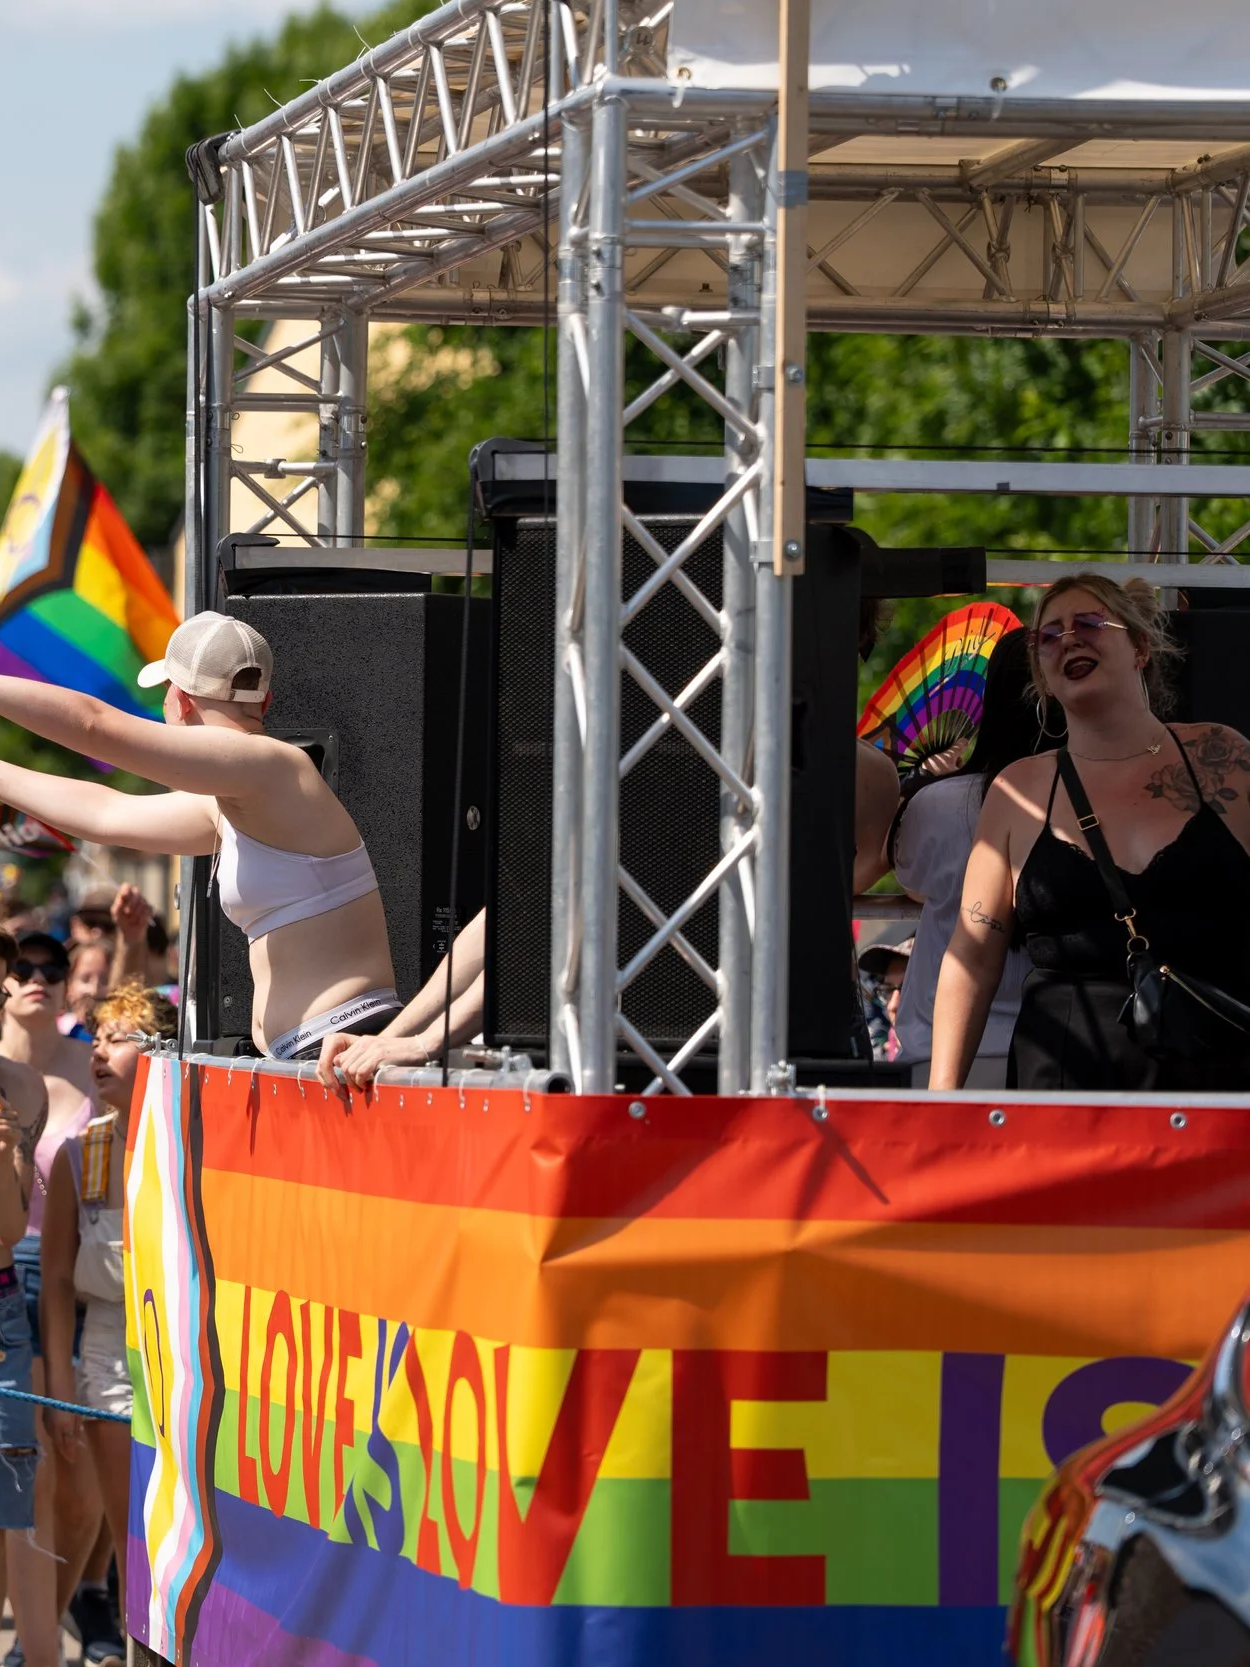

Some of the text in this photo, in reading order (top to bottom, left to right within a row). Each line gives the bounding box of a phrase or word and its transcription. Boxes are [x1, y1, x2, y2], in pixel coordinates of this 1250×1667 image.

[330, 999, 382, 1026] Calvin Klein
[276, 1031, 312, 1057] Calvin Klein
[238, 1285, 362, 1540] LOVE
[405, 1327, 828, 1606] LOVE
